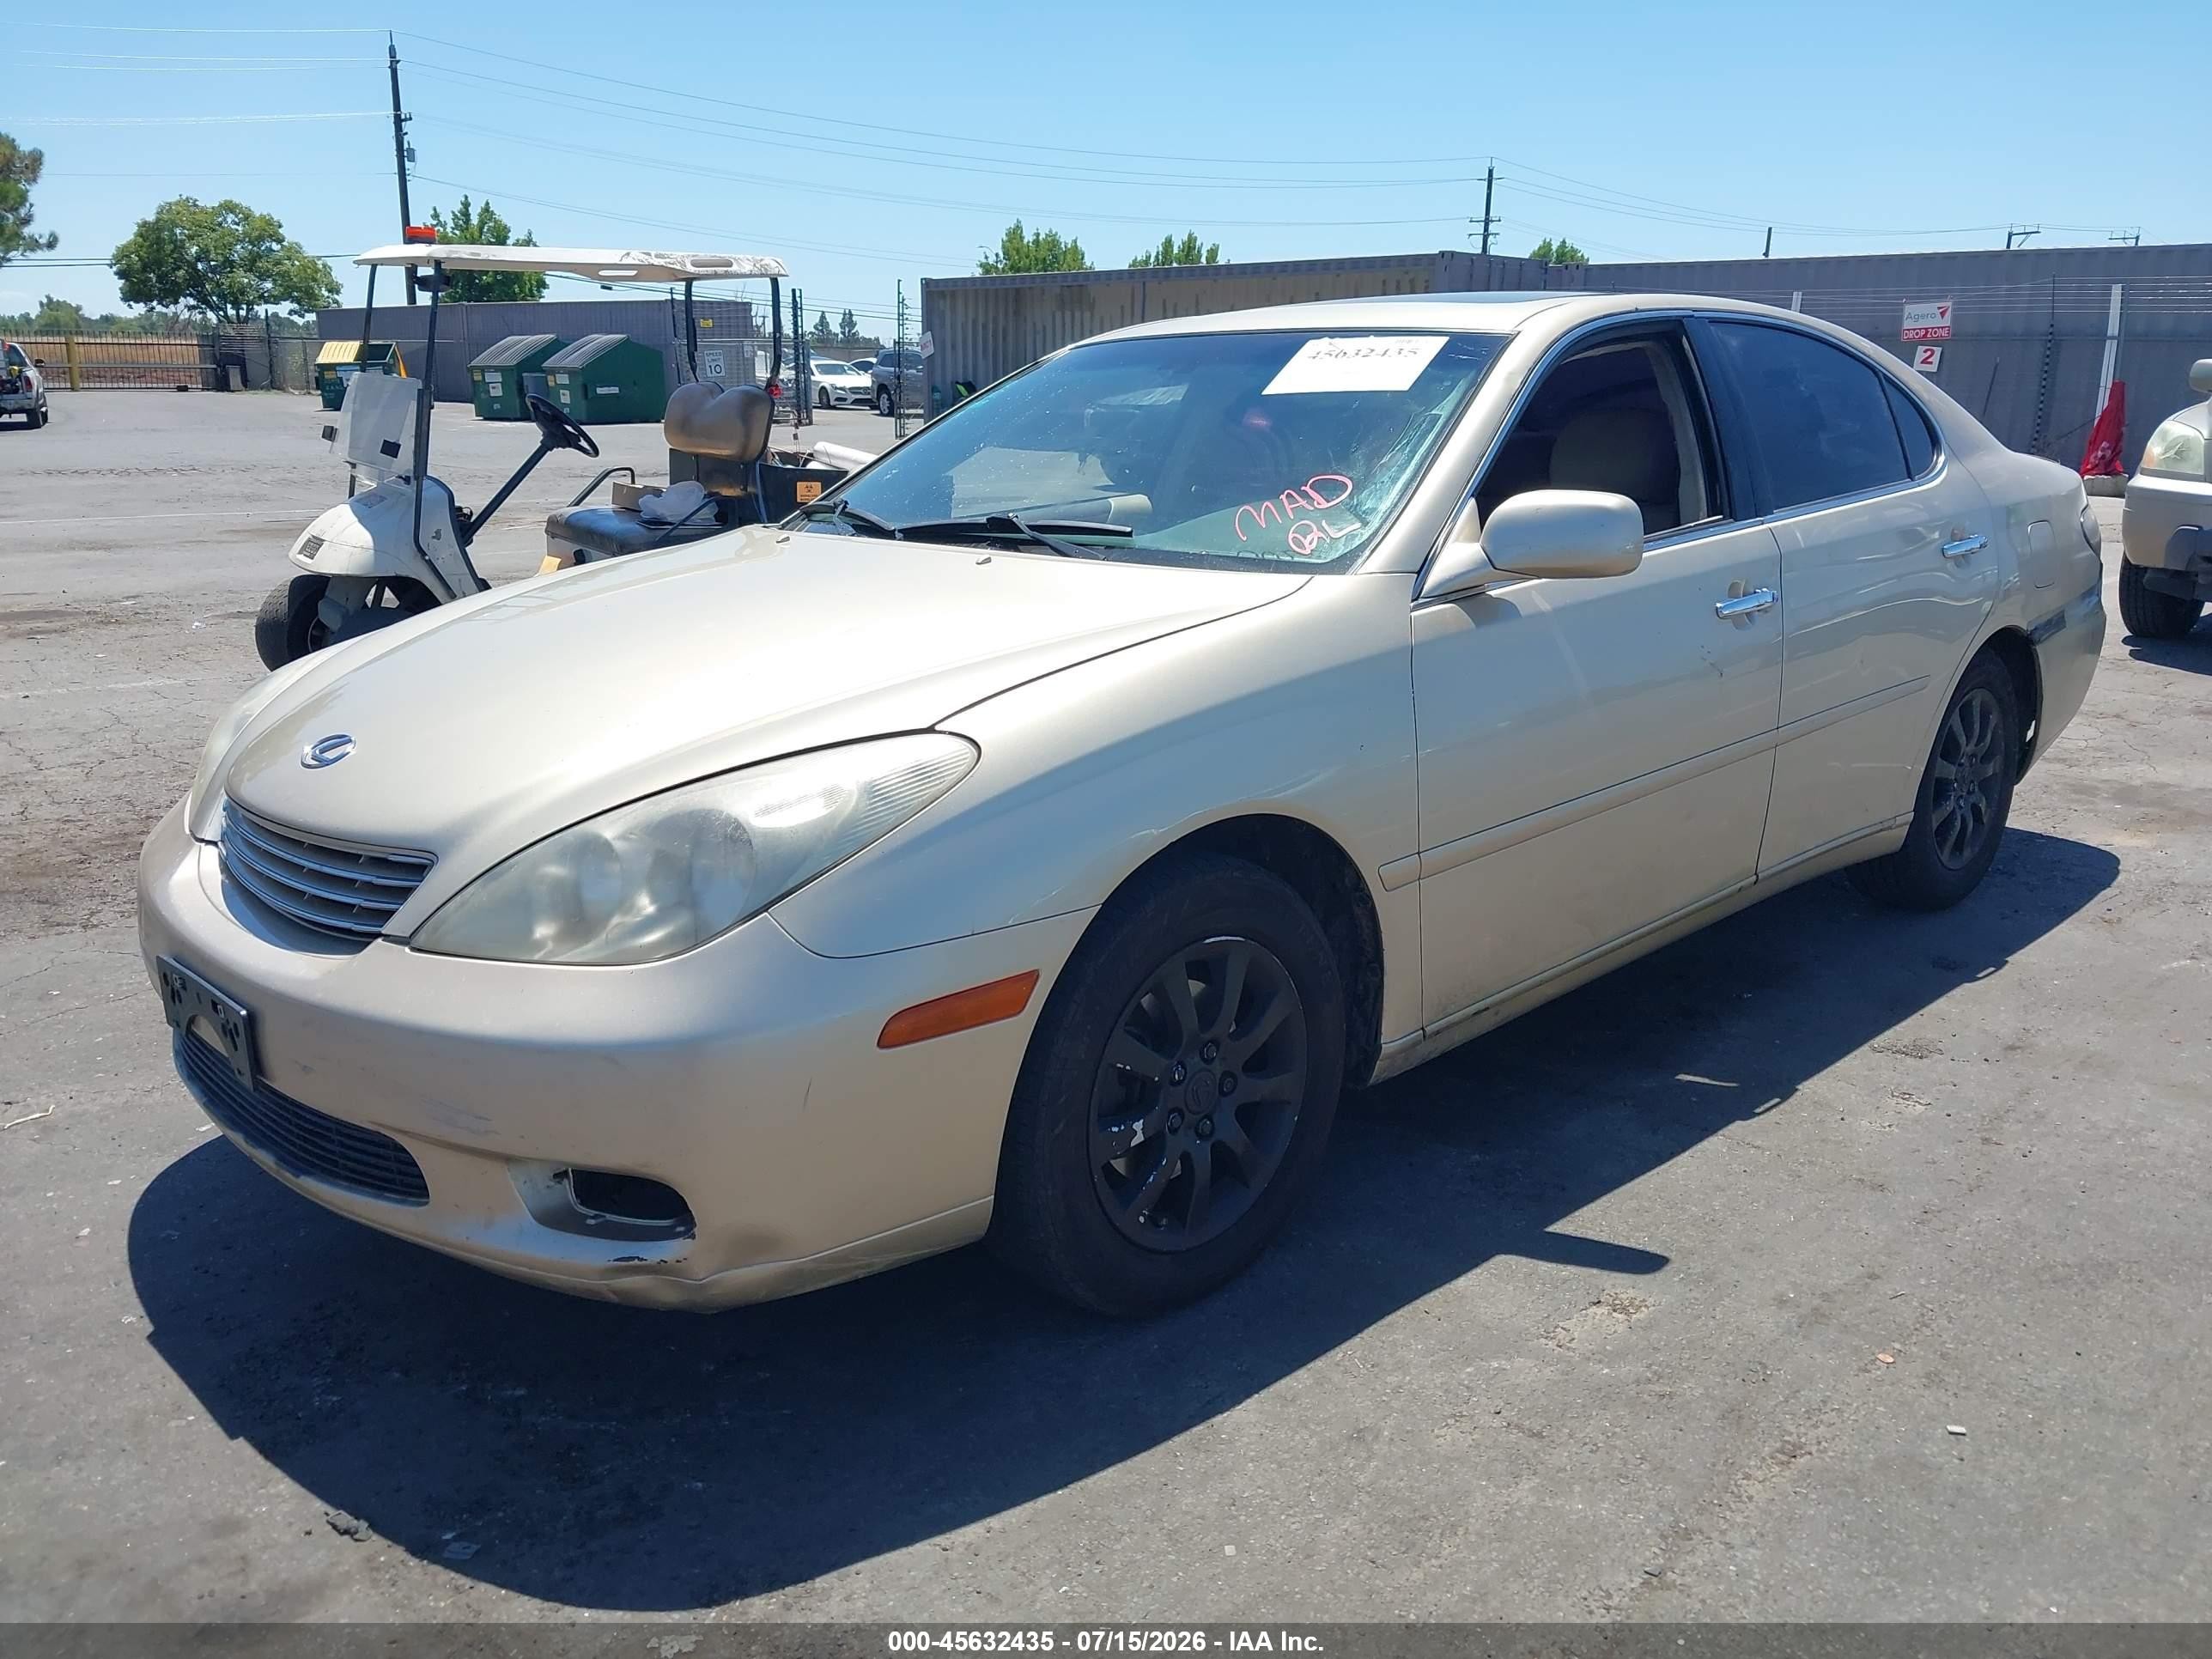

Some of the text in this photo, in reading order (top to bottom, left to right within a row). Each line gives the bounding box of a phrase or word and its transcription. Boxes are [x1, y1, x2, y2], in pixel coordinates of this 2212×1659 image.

[1905, 312, 1936, 322] Agero
[1903, 328, 1949, 339] DROP ZONE
[1920, 348, 1936, 365] 2
[708, 364, 722, 374] 10
[1235, 474, 1353, 541] MAD
